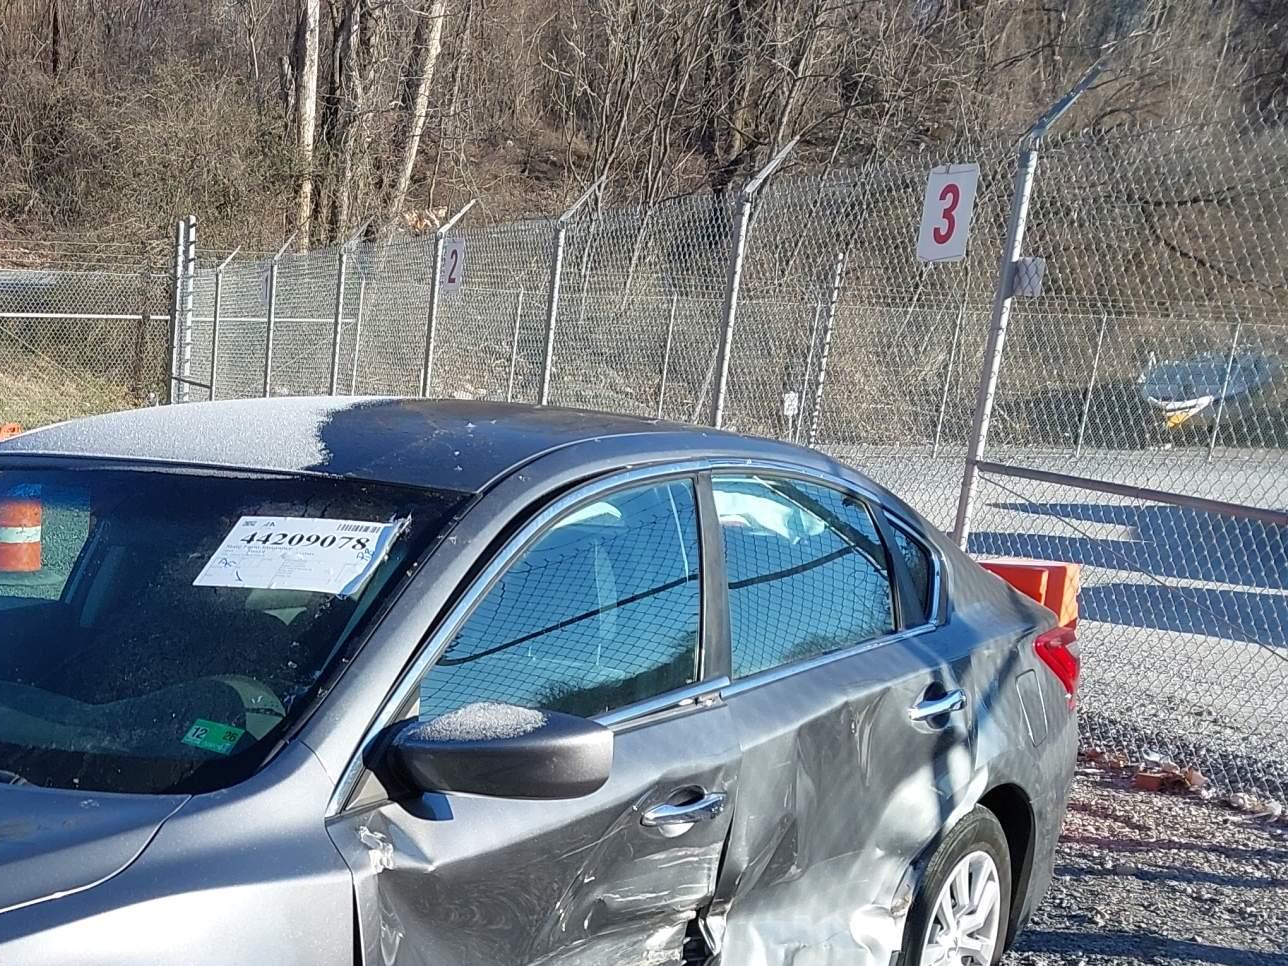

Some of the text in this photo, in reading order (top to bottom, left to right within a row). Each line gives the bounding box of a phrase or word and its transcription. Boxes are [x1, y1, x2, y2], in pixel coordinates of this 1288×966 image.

[933, 183, 961, 245] 3
[448, 249, 458, 283] 2
[240, 531, 370, 550] 44209078
[192, 727, 208, 740] 12
